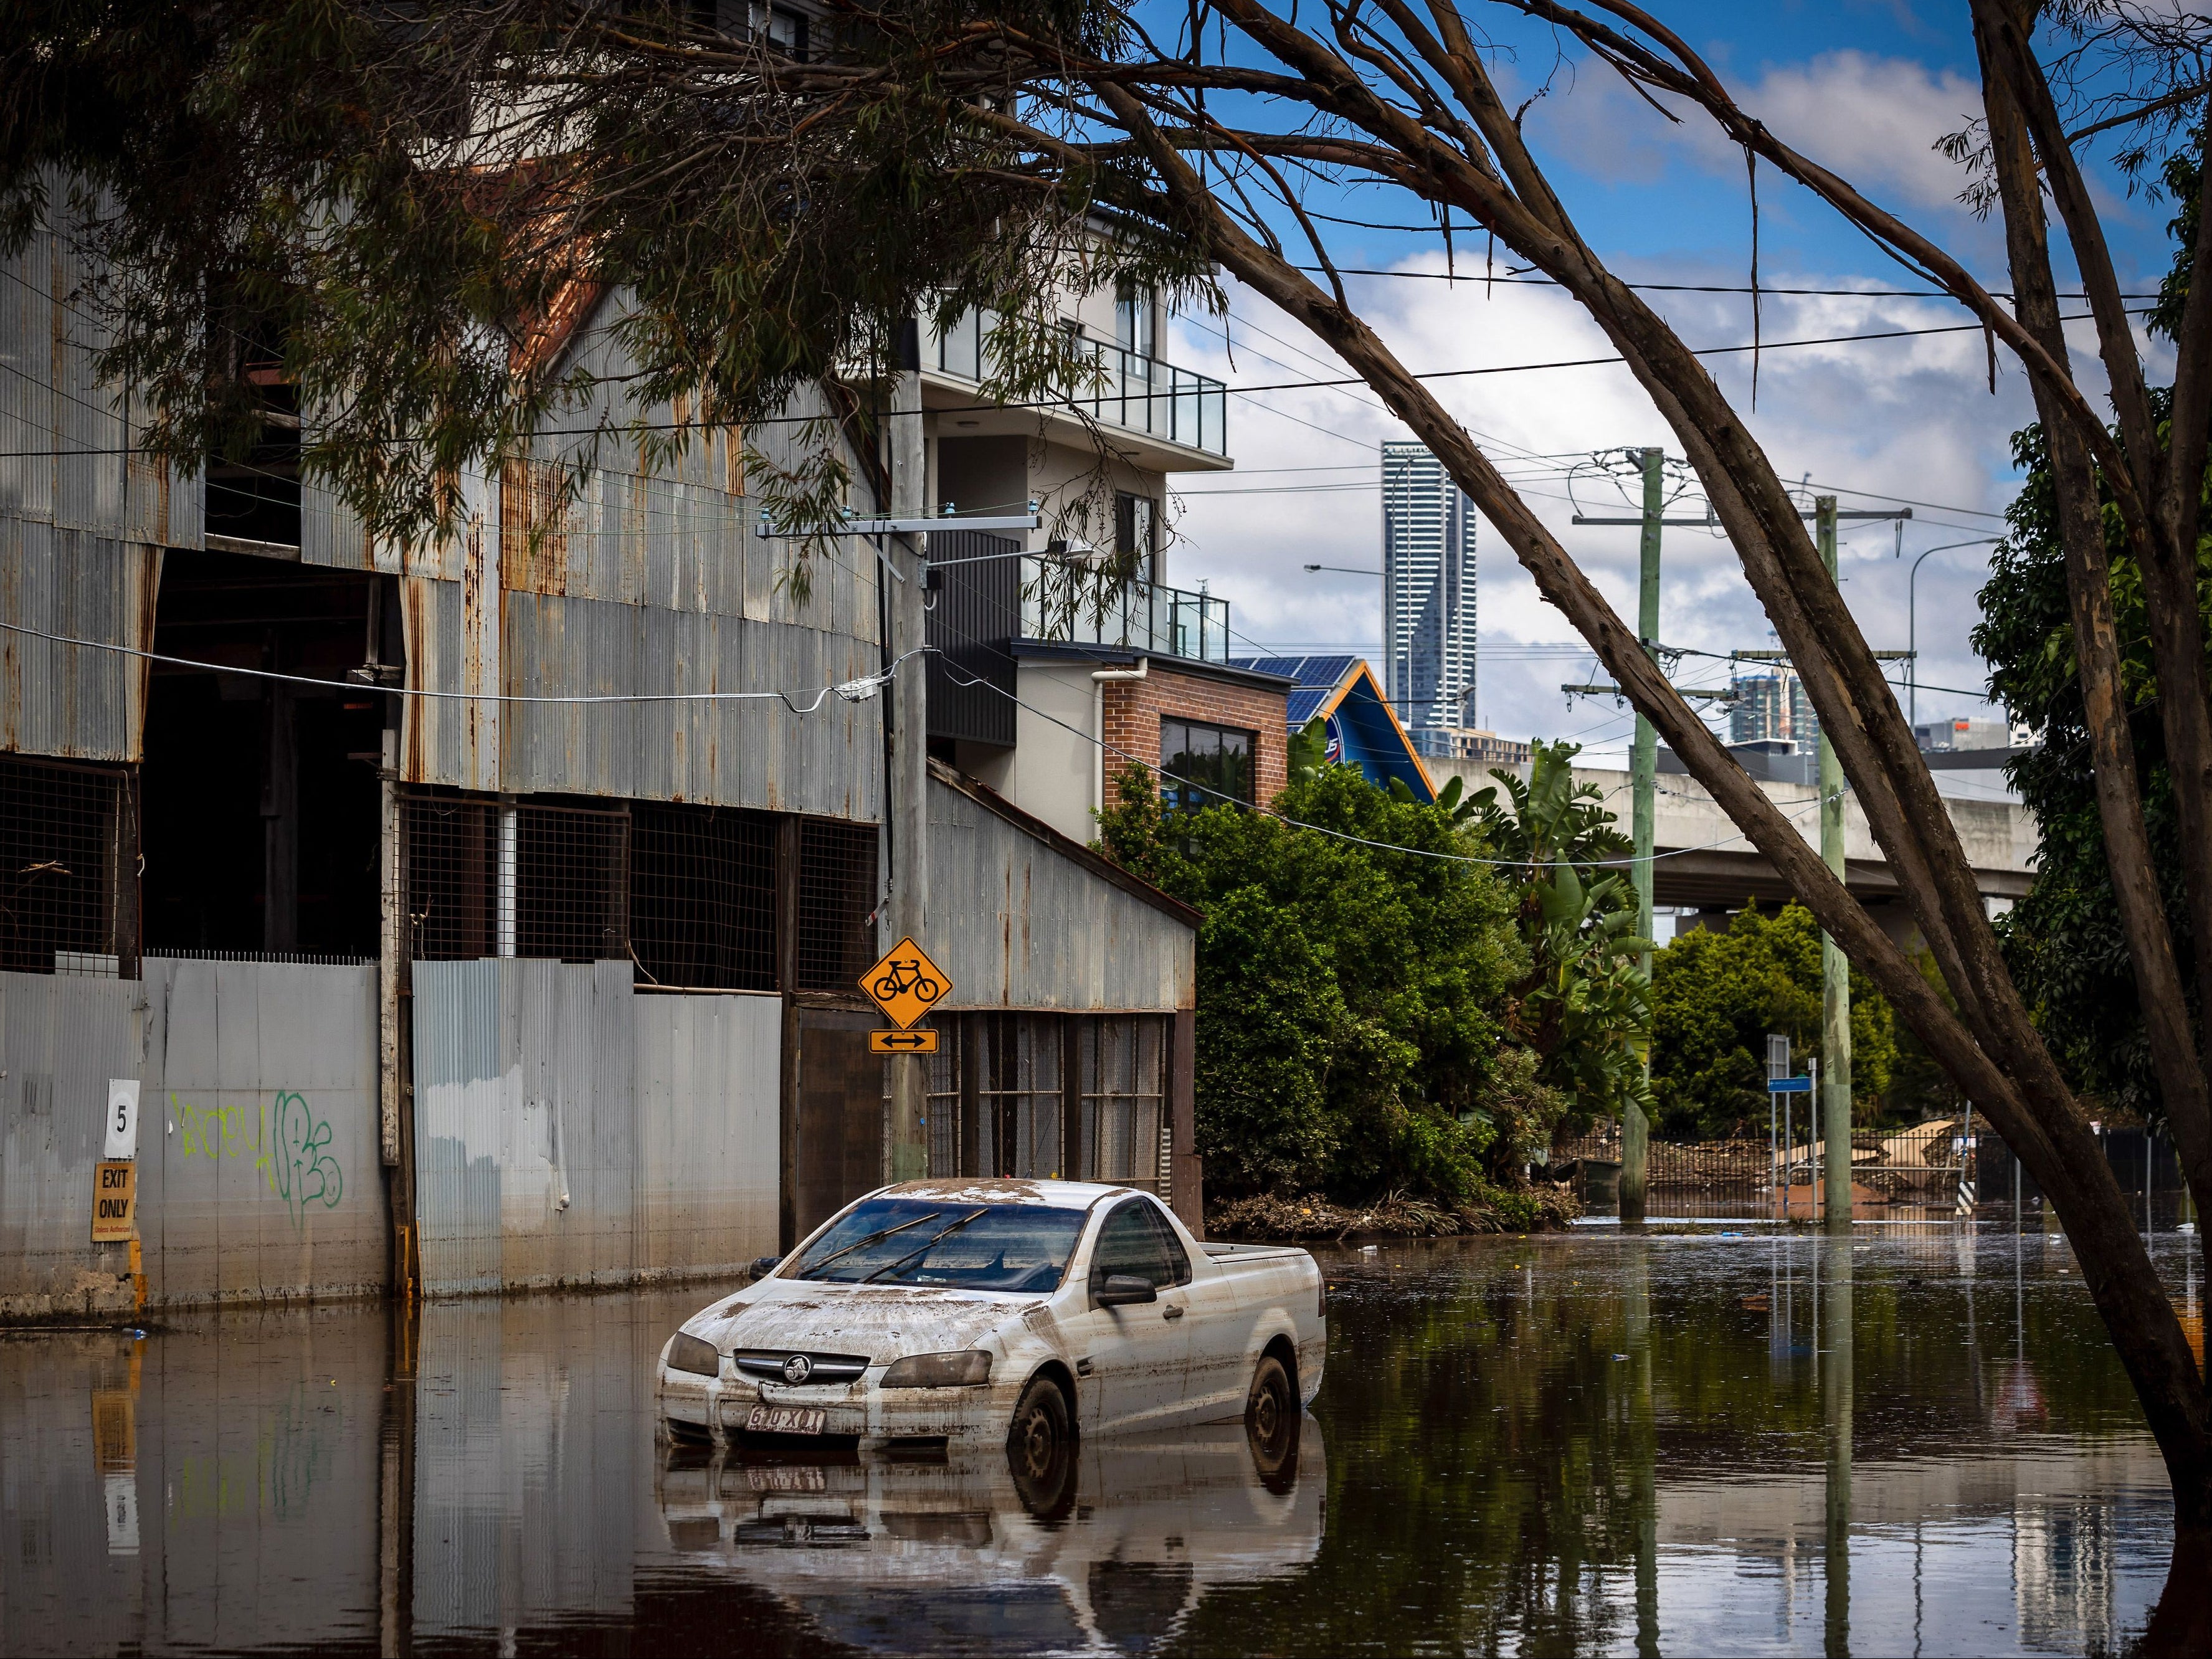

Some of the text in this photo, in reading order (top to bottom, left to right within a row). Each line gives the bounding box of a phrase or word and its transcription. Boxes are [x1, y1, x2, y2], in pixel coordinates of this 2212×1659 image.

[116, 1105, 126, 1133] 5
[102, 1169, 128, 1188] EXIT
[100, 1199, 129, 1219] ONLY
